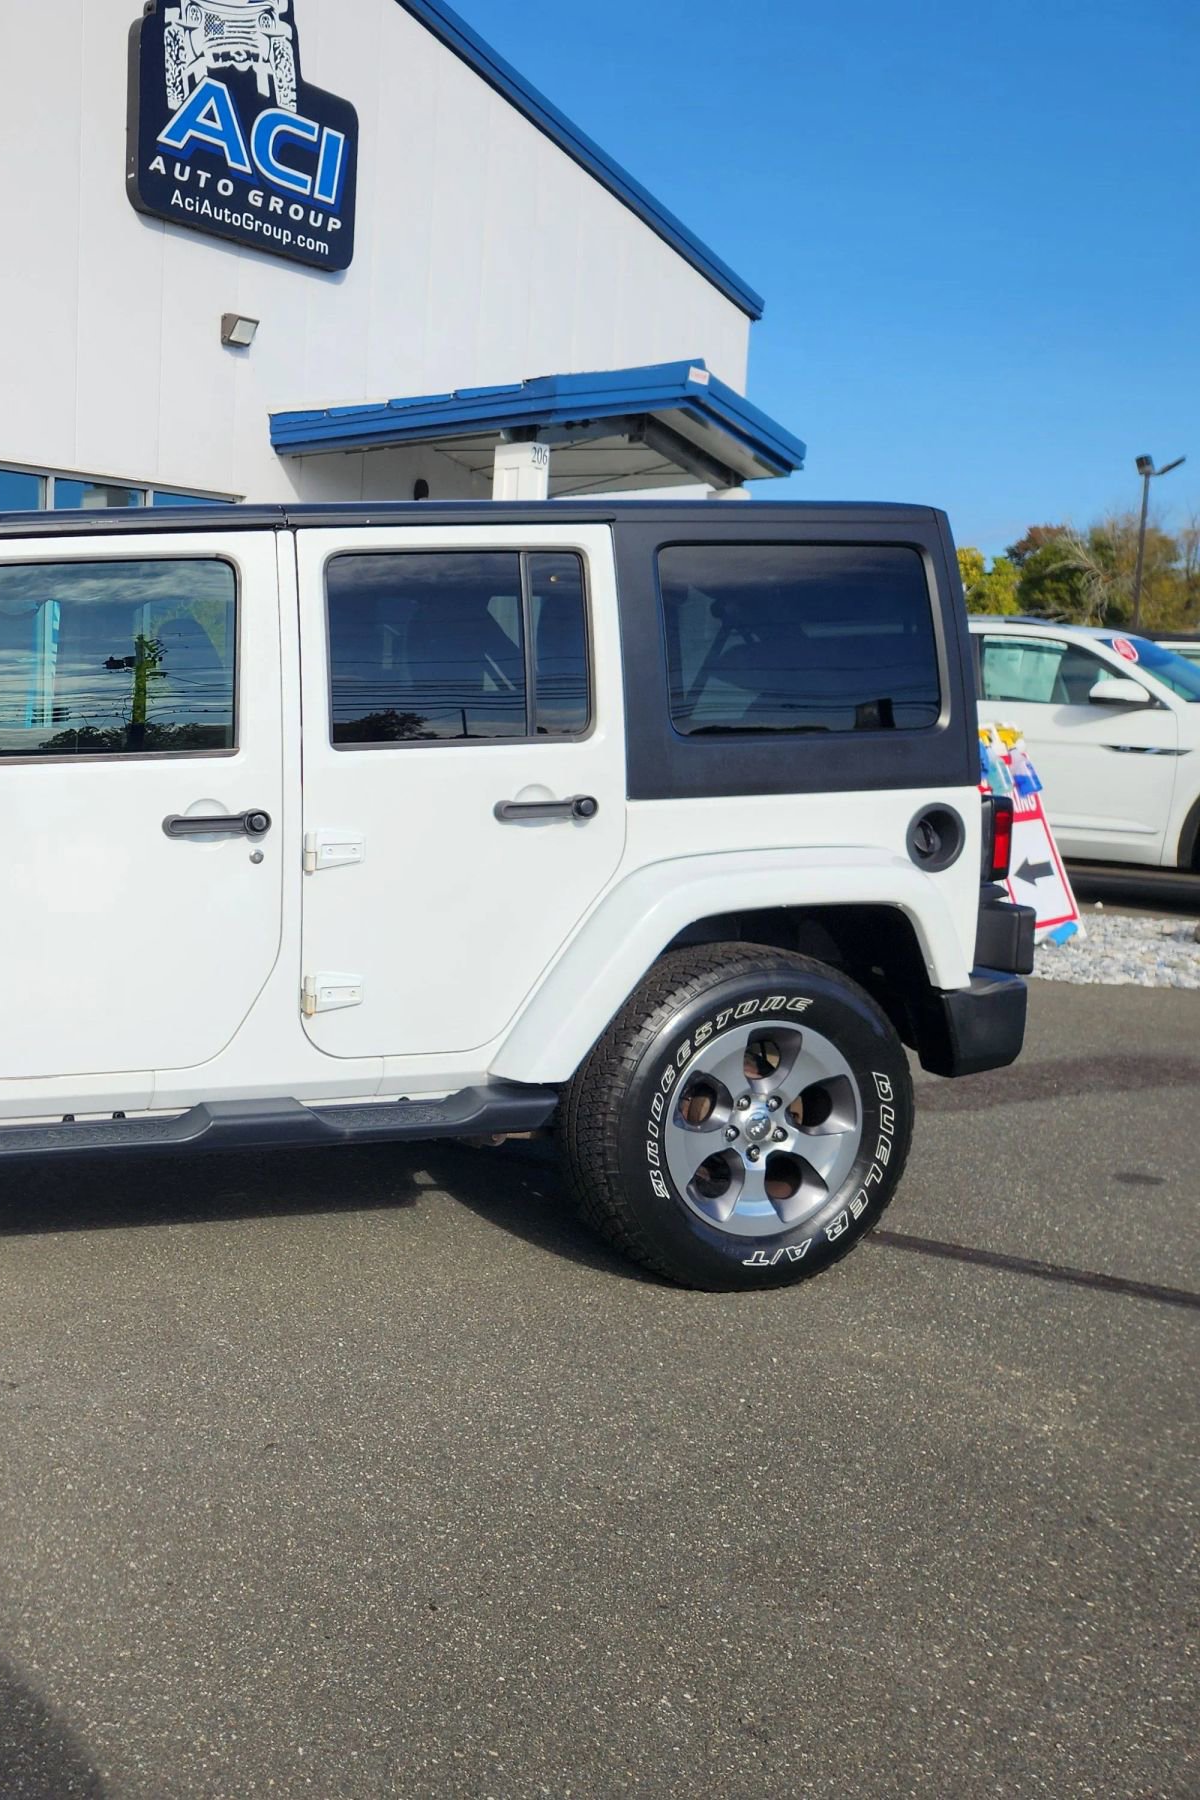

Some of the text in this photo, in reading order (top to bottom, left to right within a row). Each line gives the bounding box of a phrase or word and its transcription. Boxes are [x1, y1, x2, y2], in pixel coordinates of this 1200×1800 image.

[156, 75, 346, 206] ACI
[148, 155, 342, 232] AUTO GROUP
[171, 189, 329, 255] AciAutoGroup.com
[531, 446, 548, 466] 206
[647, 996, 814, 1200] BRIDGESTONE
[742, 1071, 895, 1266] DUELER A/T
